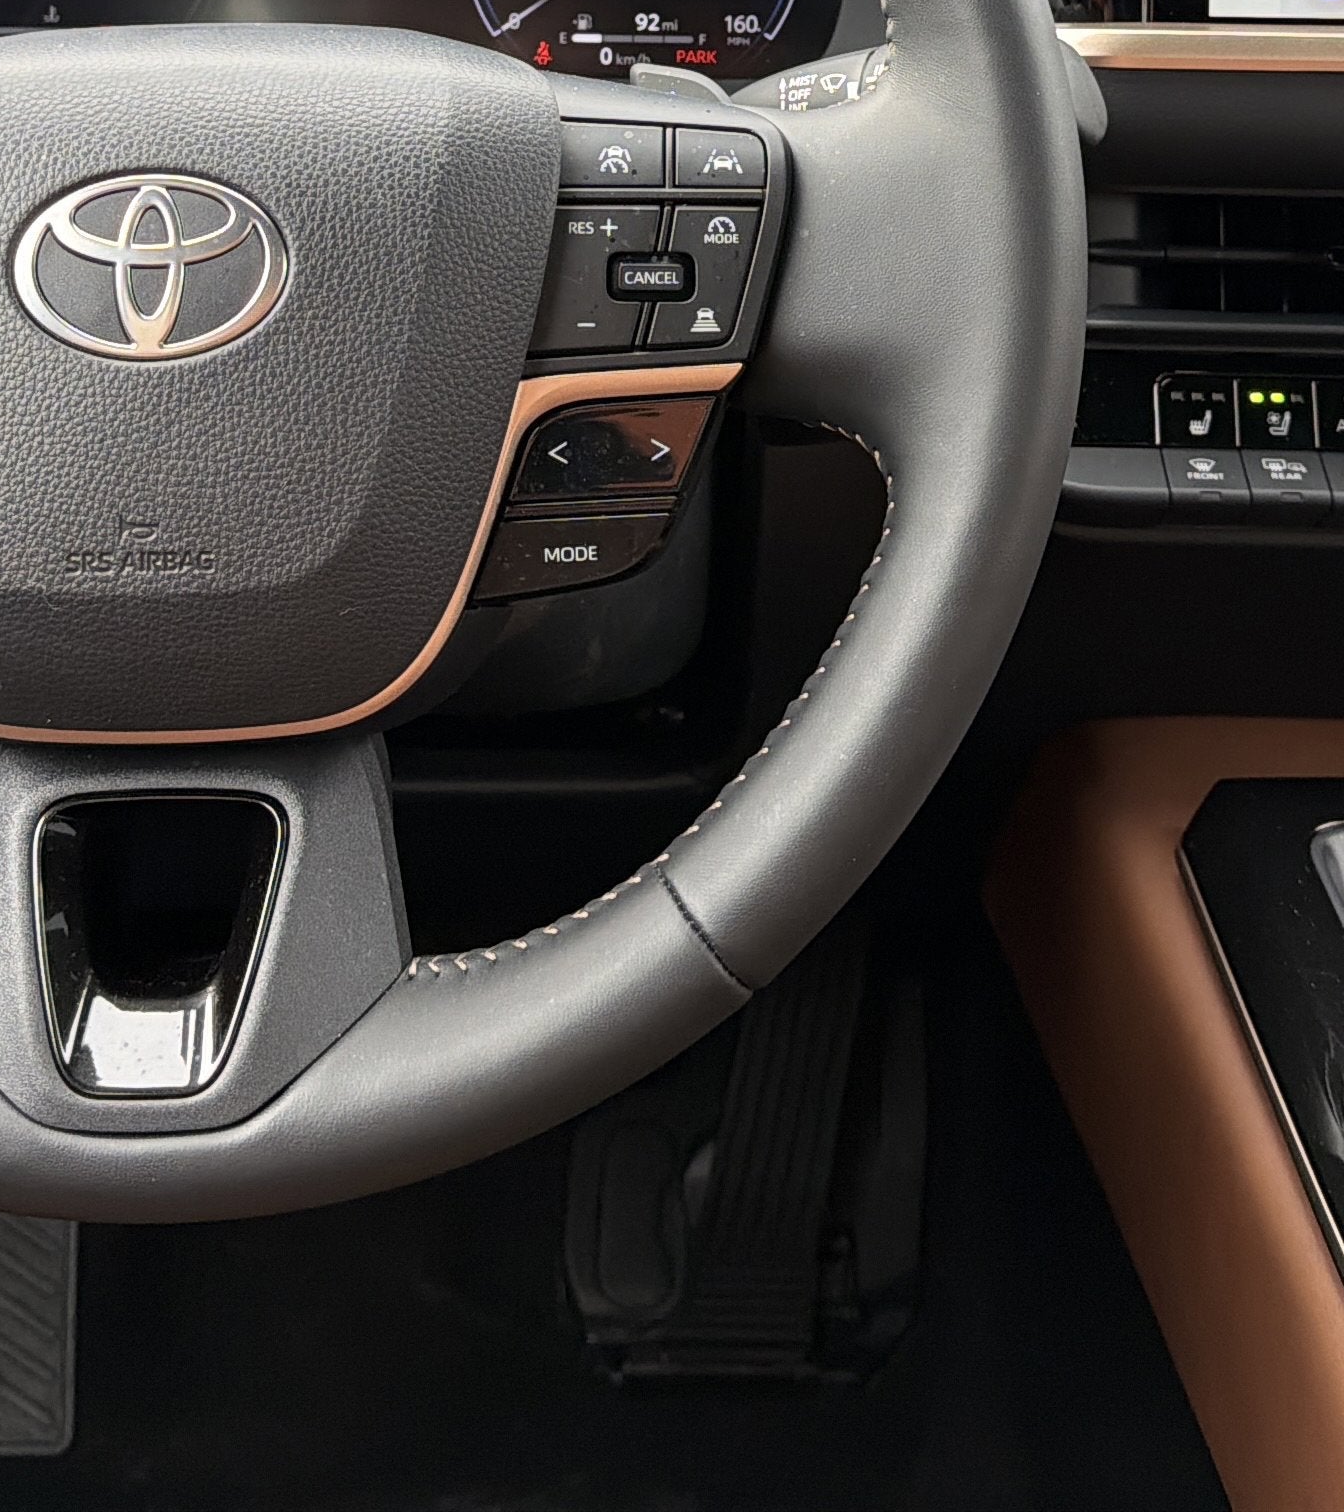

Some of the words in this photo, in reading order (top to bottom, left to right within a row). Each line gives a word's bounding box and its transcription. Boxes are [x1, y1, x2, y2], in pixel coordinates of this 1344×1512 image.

[634, 13, 660, 32] 92
[661, 19, 678, 32] mi
[724, 15, 757, 33] 160
[559, 32, 568, 45] E
[726, 36, 751, 46] MPH
[599, 46, 613, 66] 0
[615, 51, 651, 65] km/h
[676, 50, 718, 64] PARK
[788, 74, 818, 88] MIST
[788, 88, 812, 101] OFF
[568, 221, 595, 235] RES
[704, 234, 740, 244] MODE
[624, 271, 680, 285] CANCEL
[1186, 471, 1225, 481] FRONT
[1270, 472, 1303, 481] REAR
[544, 545, 599, 563] MODE
[64, 551, 115, 575] SRS
[119, 550, 216, 575] AIRBAG
